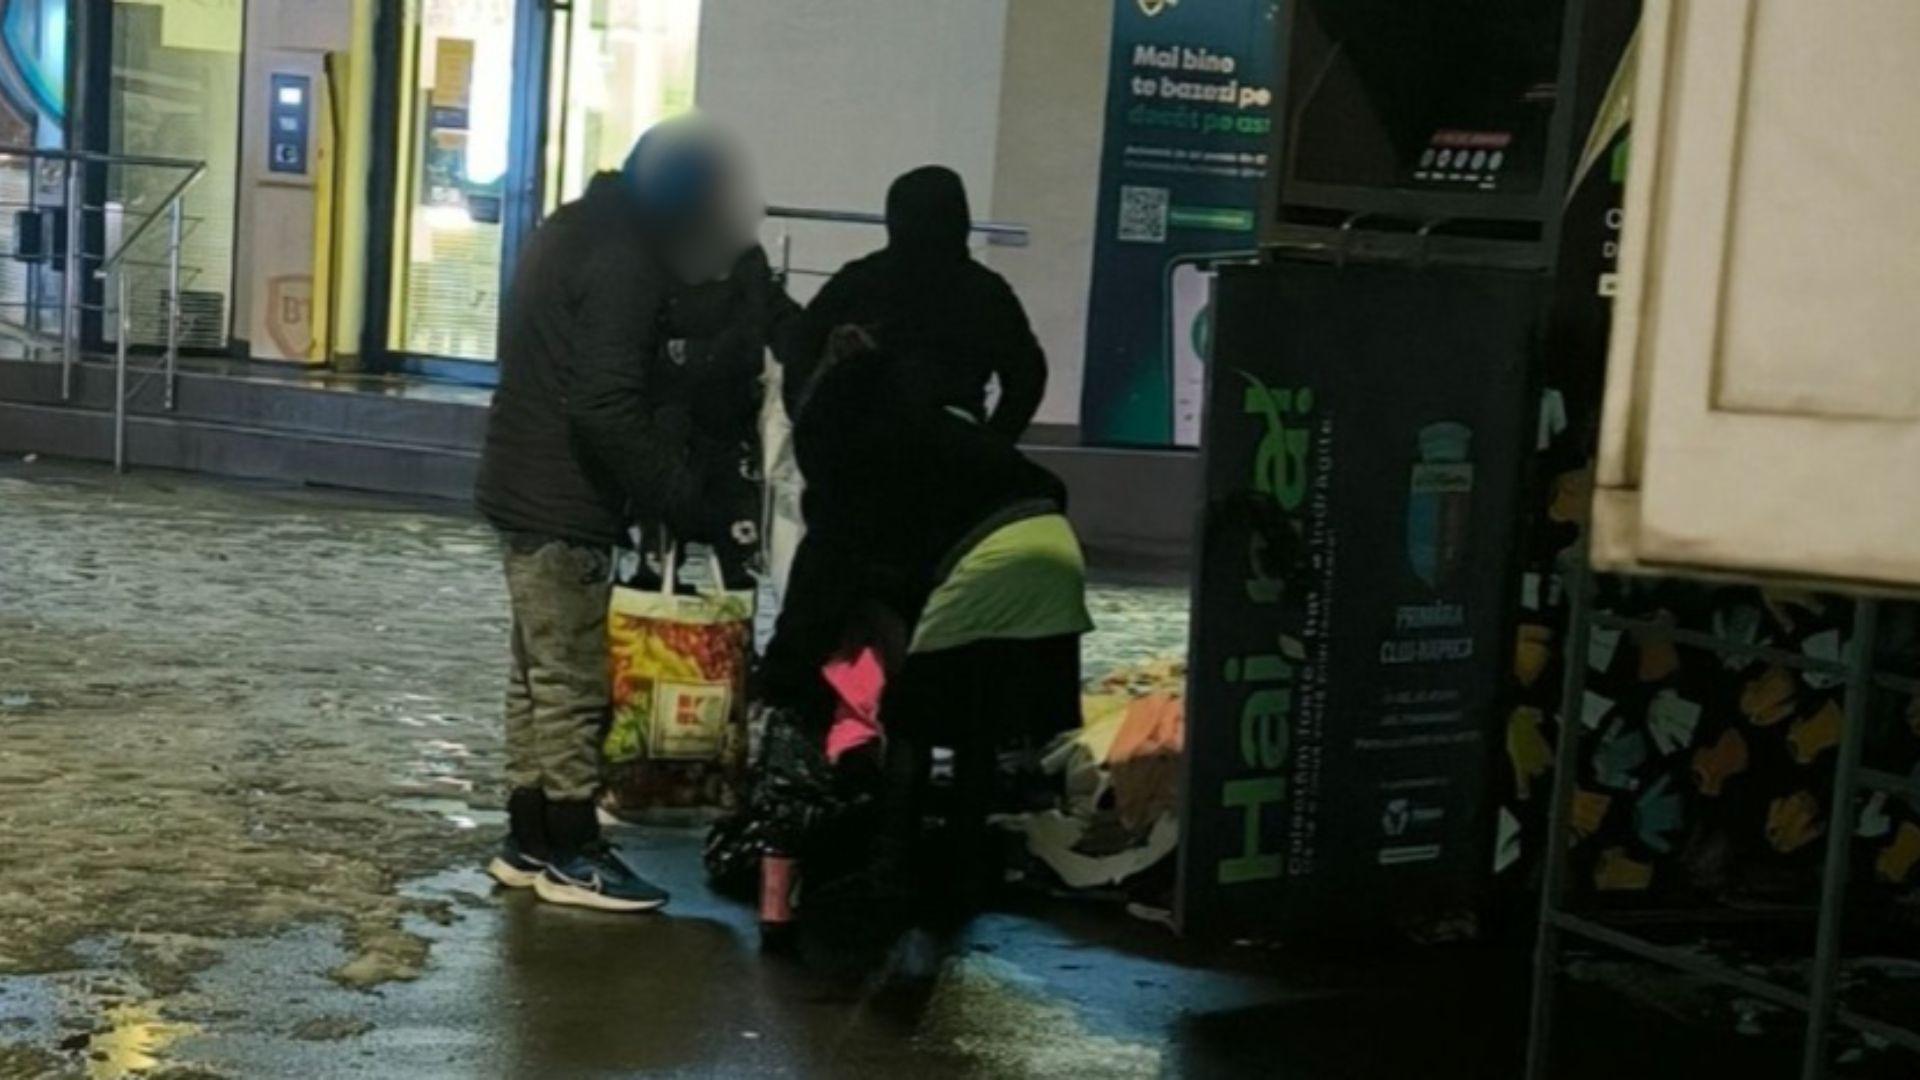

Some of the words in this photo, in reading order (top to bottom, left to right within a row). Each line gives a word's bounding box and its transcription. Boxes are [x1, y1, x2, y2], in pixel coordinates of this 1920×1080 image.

[1132, 45, 1180, 69] Mai
[1182, 47, 1235, 73] bine
[1132, 76, 1157, 96] te
[1160, 75, 1238, 103] bazezi
[1238, 86, 1271, 109] pe
